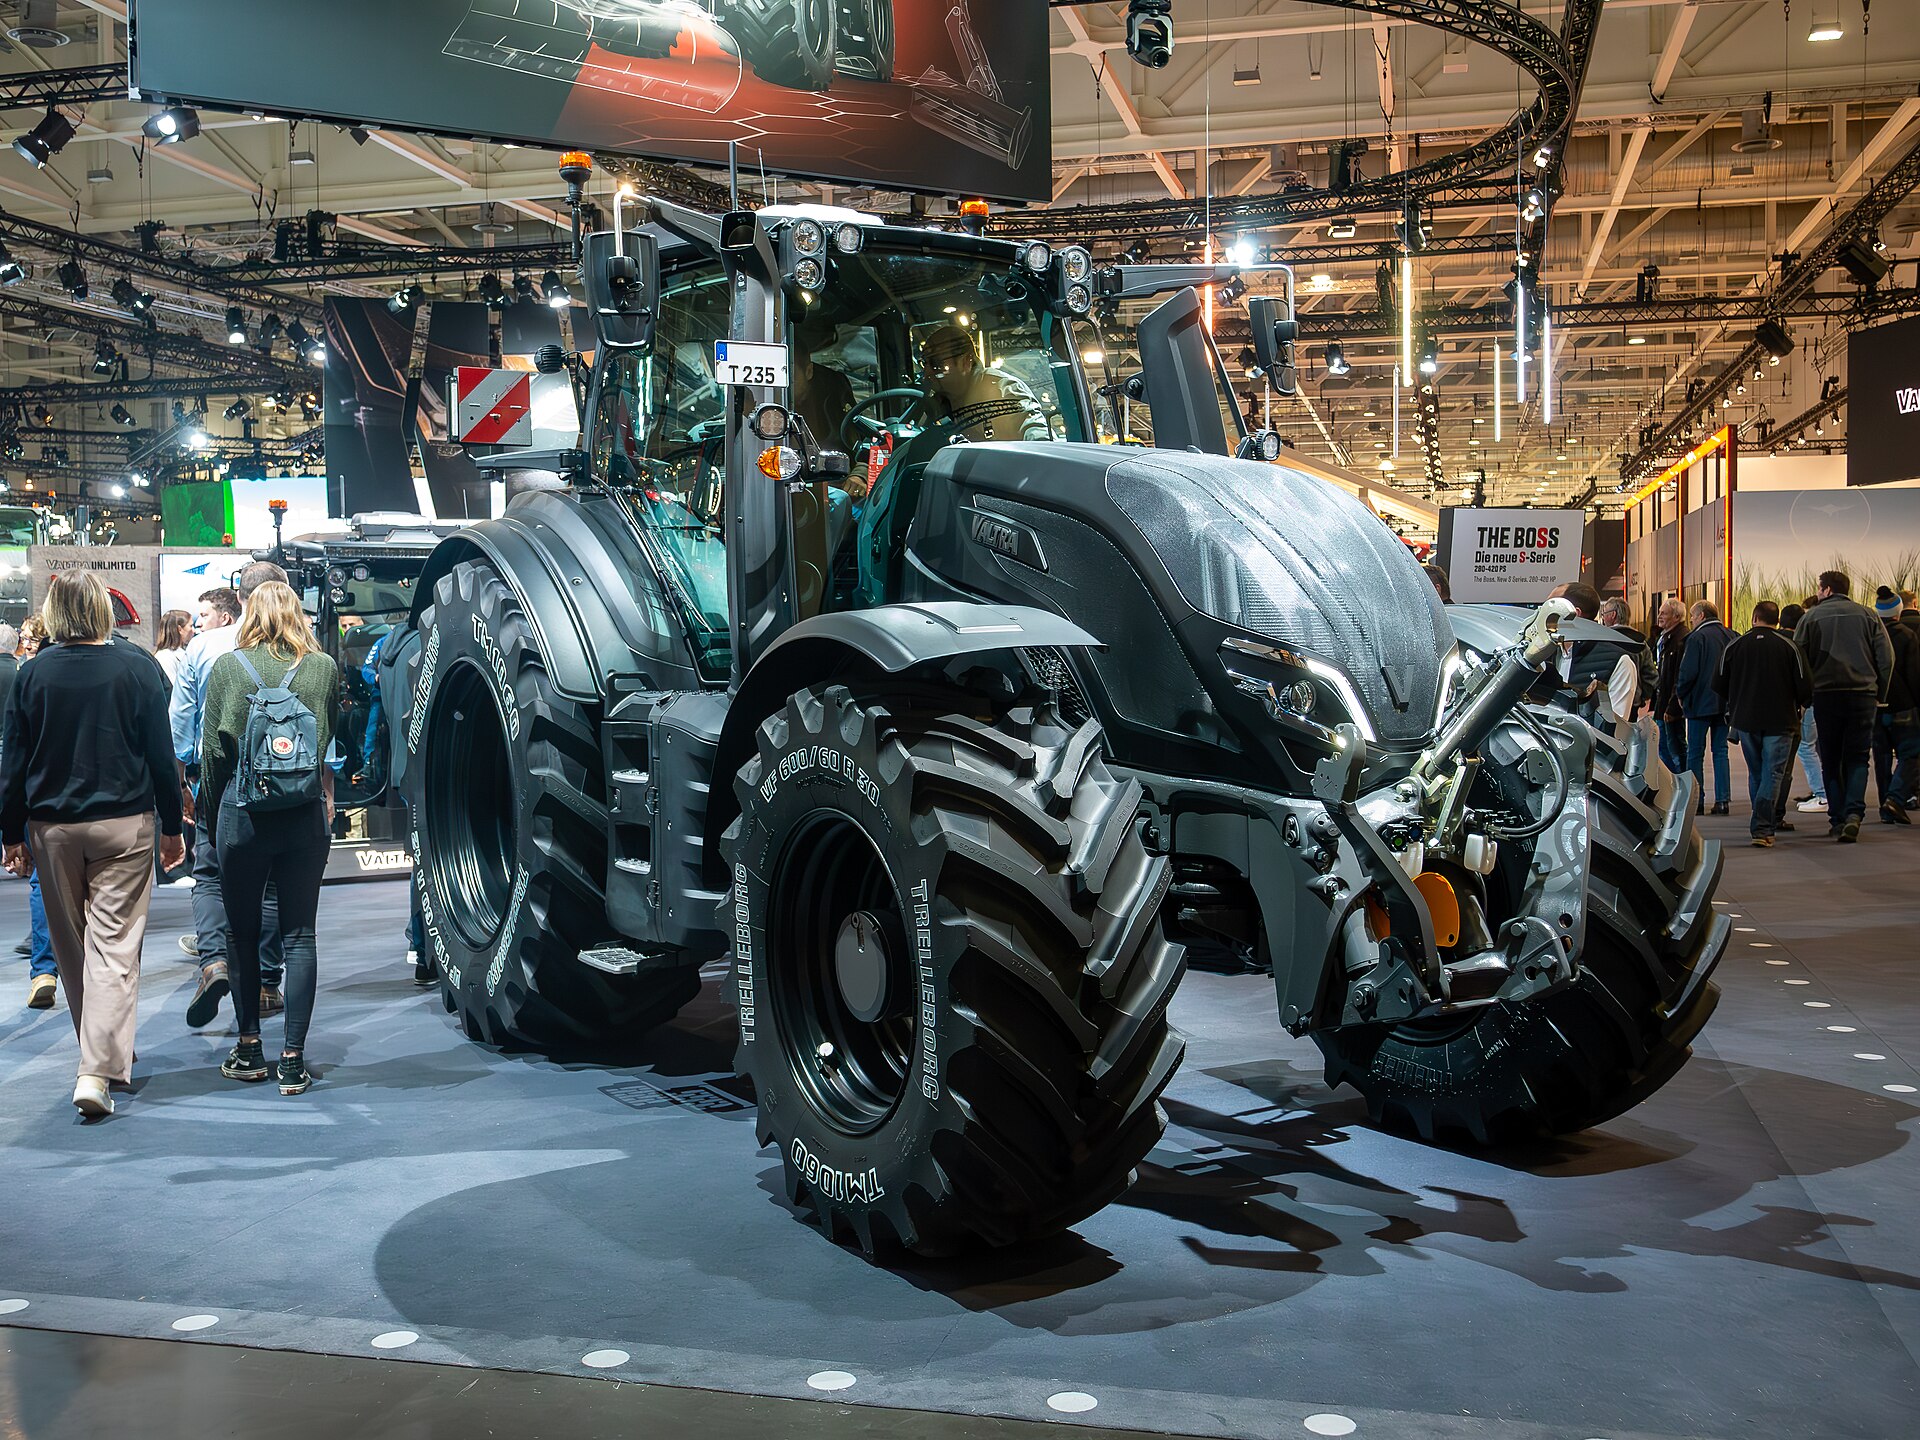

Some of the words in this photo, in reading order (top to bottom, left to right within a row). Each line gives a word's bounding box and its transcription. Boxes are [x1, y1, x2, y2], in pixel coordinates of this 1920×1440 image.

[728, 365, 738, 382] T
[743, 366, 775, 384] 235
[1895, 388, 1920, 414] VA
[972, 514, 1019, 555] VALTRA
[1477, 527, 1511, 548] THE
[1513, 527, 1560, 548] BOSS
[91, 561, 136, 570] UNLIMITED
[1475, 551, 1491, 563] Die
[1492, 554, 1518, 563] neue
[1519, 551, 1556, 563] S-Serie
[407, 623, 440, 755] TRELLEBORG
[472, 612, 520, 742] TM1060
[759, 769, 778, 804] VF
[778, 746, 841, 781] 600/60
[843, 755, 855, 782] R
[856, 767, 880, 807] 30
[355, 850, 414, 870] VALTR
[735, 862, 755, 1046] TRELLEBORG
[910, 878, 939, 1101] TRELLEBORG
[791, 1137, 885, 1204] TM1060
